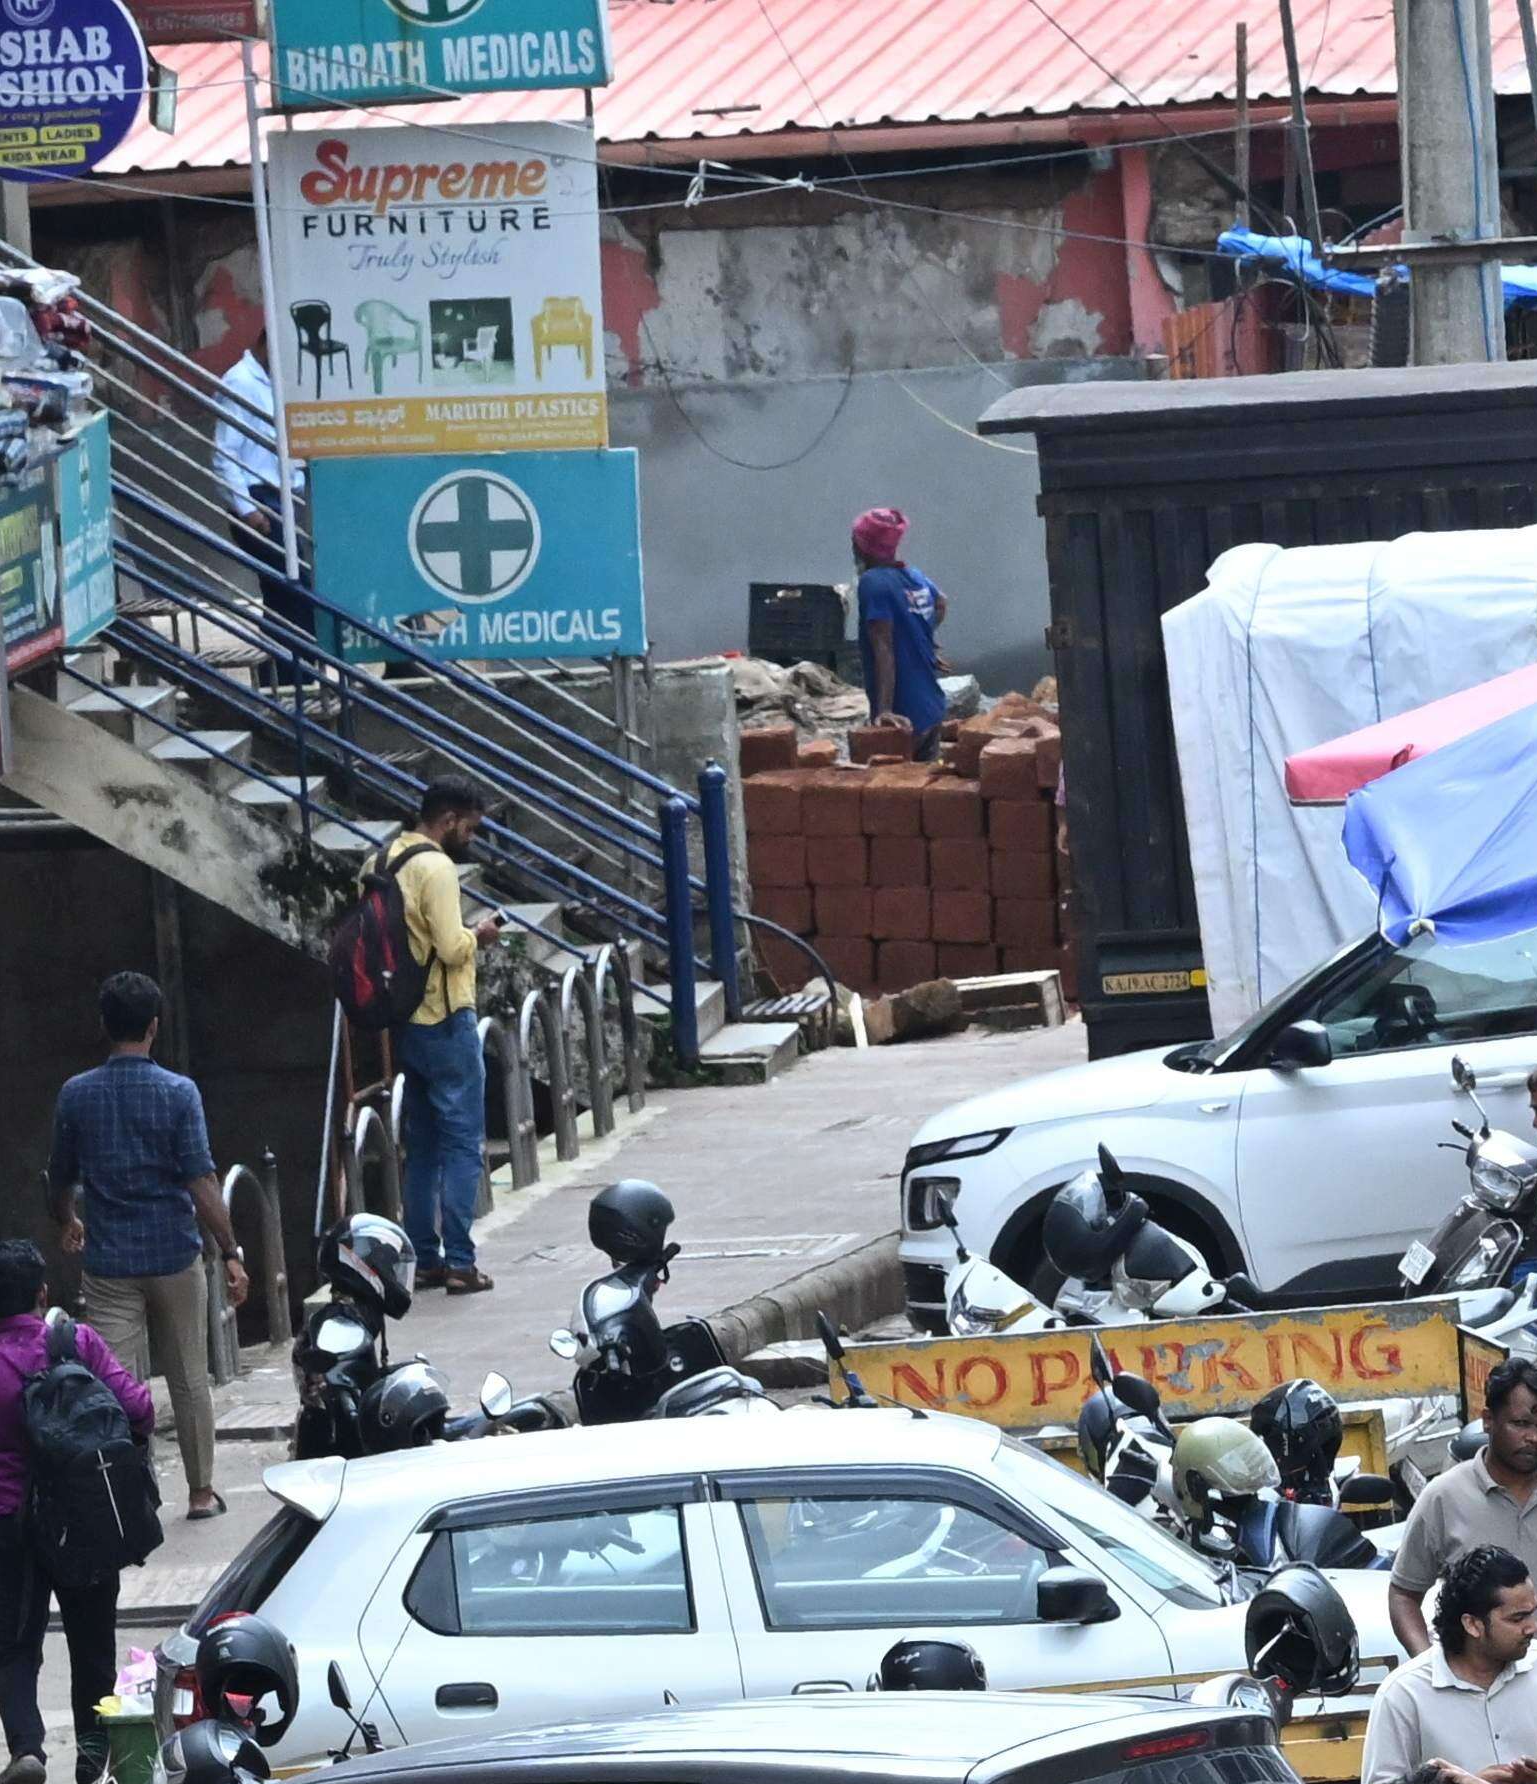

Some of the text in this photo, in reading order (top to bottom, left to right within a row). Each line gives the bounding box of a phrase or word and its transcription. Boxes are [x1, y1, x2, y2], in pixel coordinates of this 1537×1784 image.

[286, 27, 597, 92] BHARATH MEDICALS
[46, 125, 94, 141] LADIES
[3, 147, 78, 163] KIDS WEAR
[300, 139, 548, 216] Supreme
[303, 206, 552, 240] FURNITURE
[348, 237, 504, 280] Truly Stylish
[425, 400, 508, 423] MARUTHI
[515, 397, 600, 419] PLASTICS
[479, 607, 622, 646] MEDICALS
[891, 1355, 1008, 1408] NO
